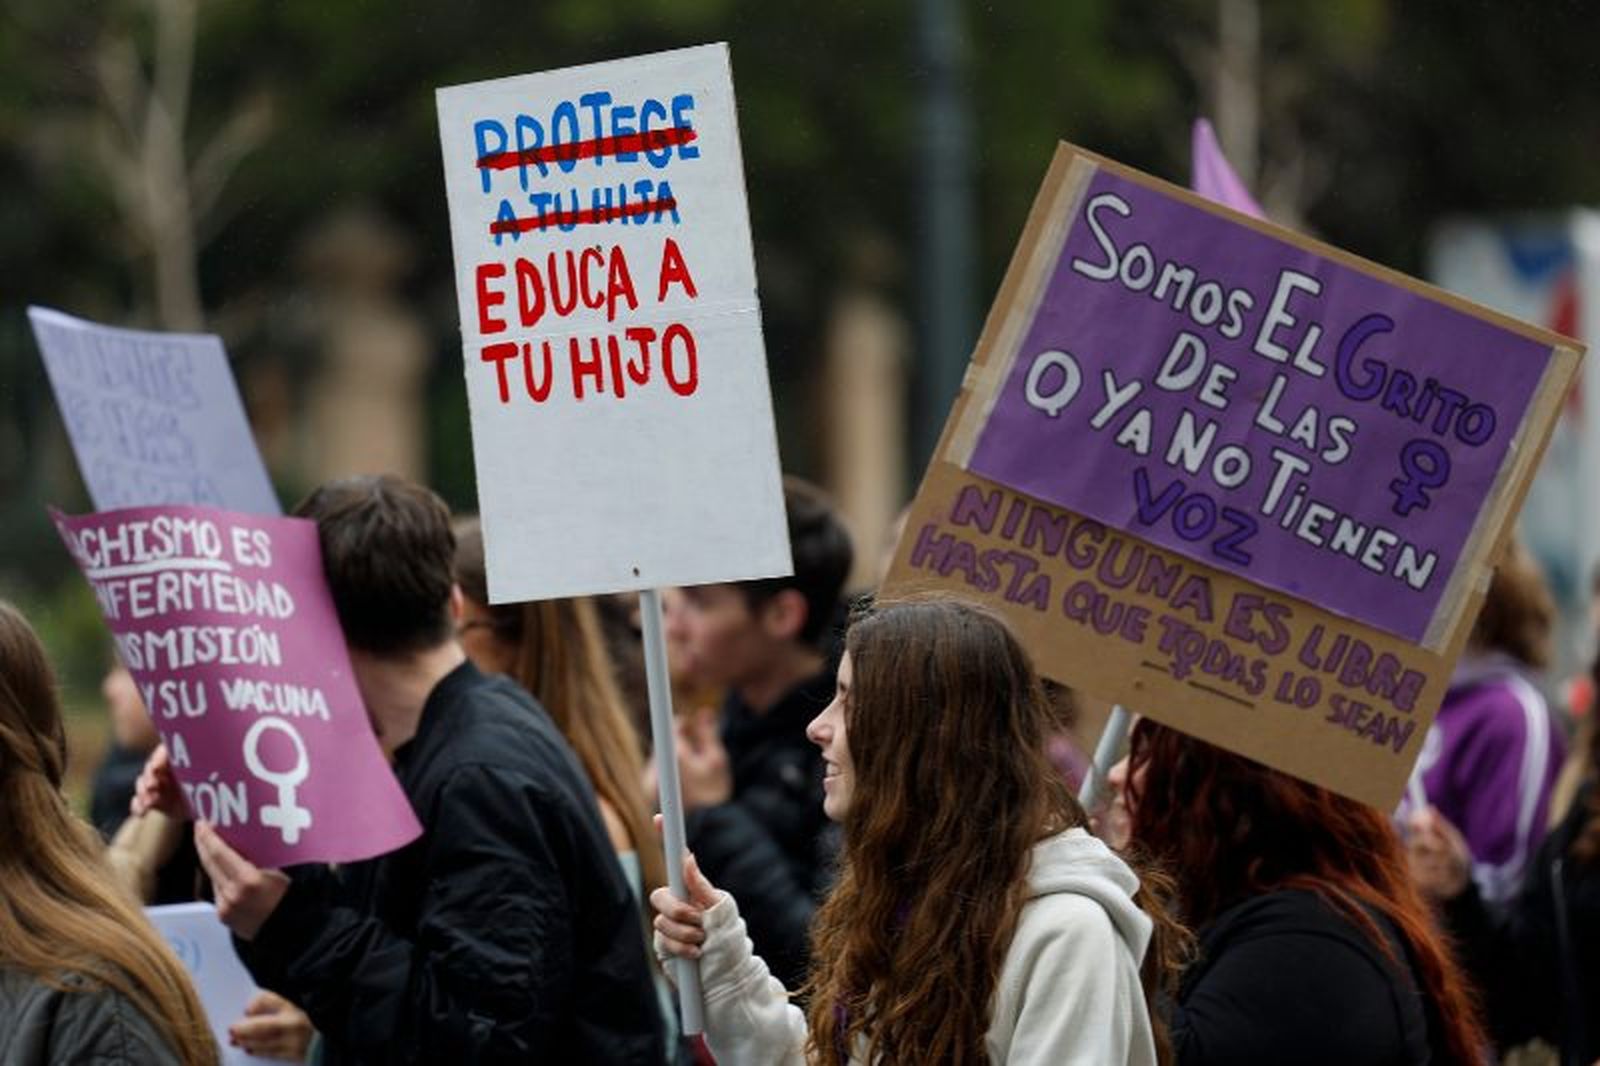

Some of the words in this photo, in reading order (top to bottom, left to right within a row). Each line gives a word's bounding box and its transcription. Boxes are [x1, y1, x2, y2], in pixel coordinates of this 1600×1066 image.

[474, 91, 701, 193] PROTEGE
[529, 188, 579, 232] TU
[592, 179, 681, 226] HIJA
[476, 245, 638, 334] EDUCA
[658, 237, 698, 302] A
[1071, 193, 1255, 339] SOMOS
[1253, 268, 1327, 377] EL
[481, 341, 553, 403] TU
[569, 323, 698, 400] HIJO
[1024, 349, 1083, 417] Q
[1153, 332, 1238, 410] DE
[1254, 373, 1358, 465] LAS
[230, 526, 272, 568] ES
[1134, 466, 1258, 566] VOZ
[909, 523, 1052, 612] HASTA
[1063, 579, 1151, 643] QUE
[1158, 614, 1268, 695] TODAS
[1274, 670, 1323, 710] LO
[1325, 692, 1417, 755] SEAN
[950, 483, 1214, 623] NINGUNA
[1223, 592, 1293, 655] ES
[1298, 623, 1427, 713] LIBRE
[160, 680, 207, 719] SU
[220, 677, 330, 721] VACUNA
